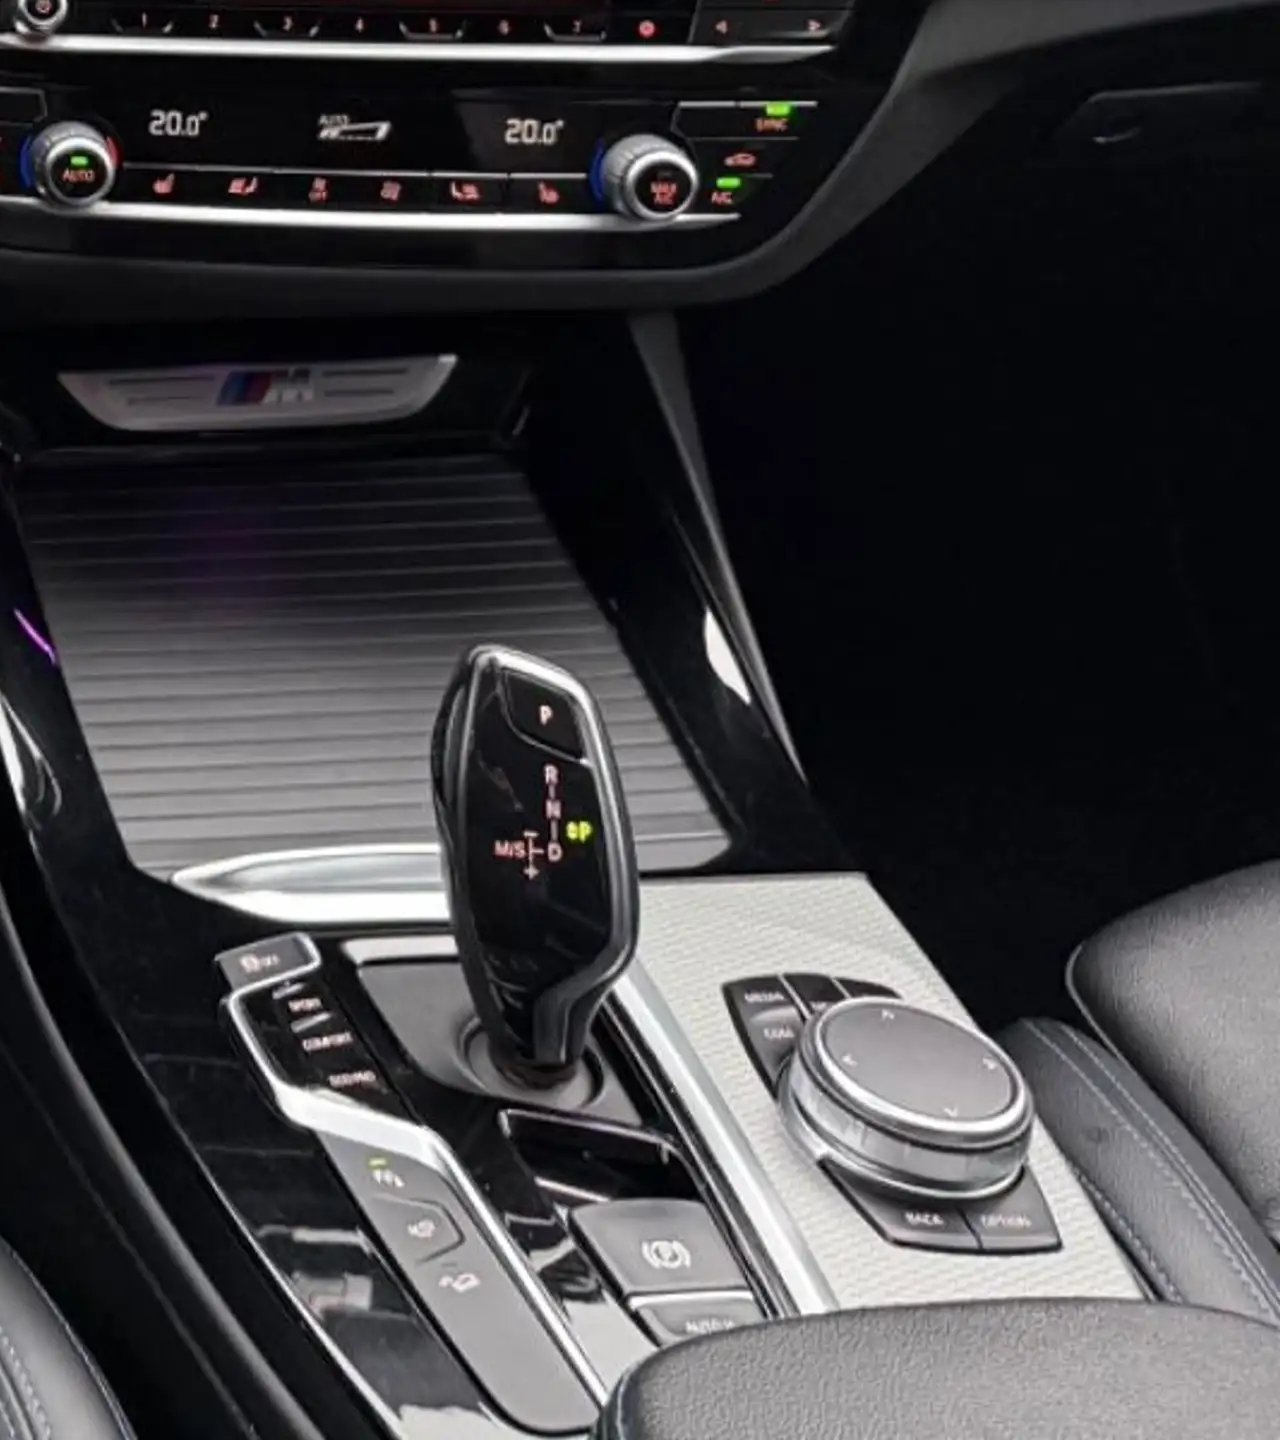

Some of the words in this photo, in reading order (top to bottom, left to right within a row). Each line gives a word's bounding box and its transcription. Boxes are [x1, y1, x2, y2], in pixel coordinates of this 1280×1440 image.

[62, 168, 96, 183] AUTO
[539, 705, 553, 725] P
[544, 765, 559, 785] R
[545, 800, 562, 819] N
[494, 840, 526, 859] M/S
[547, 842, 563, 862] D
